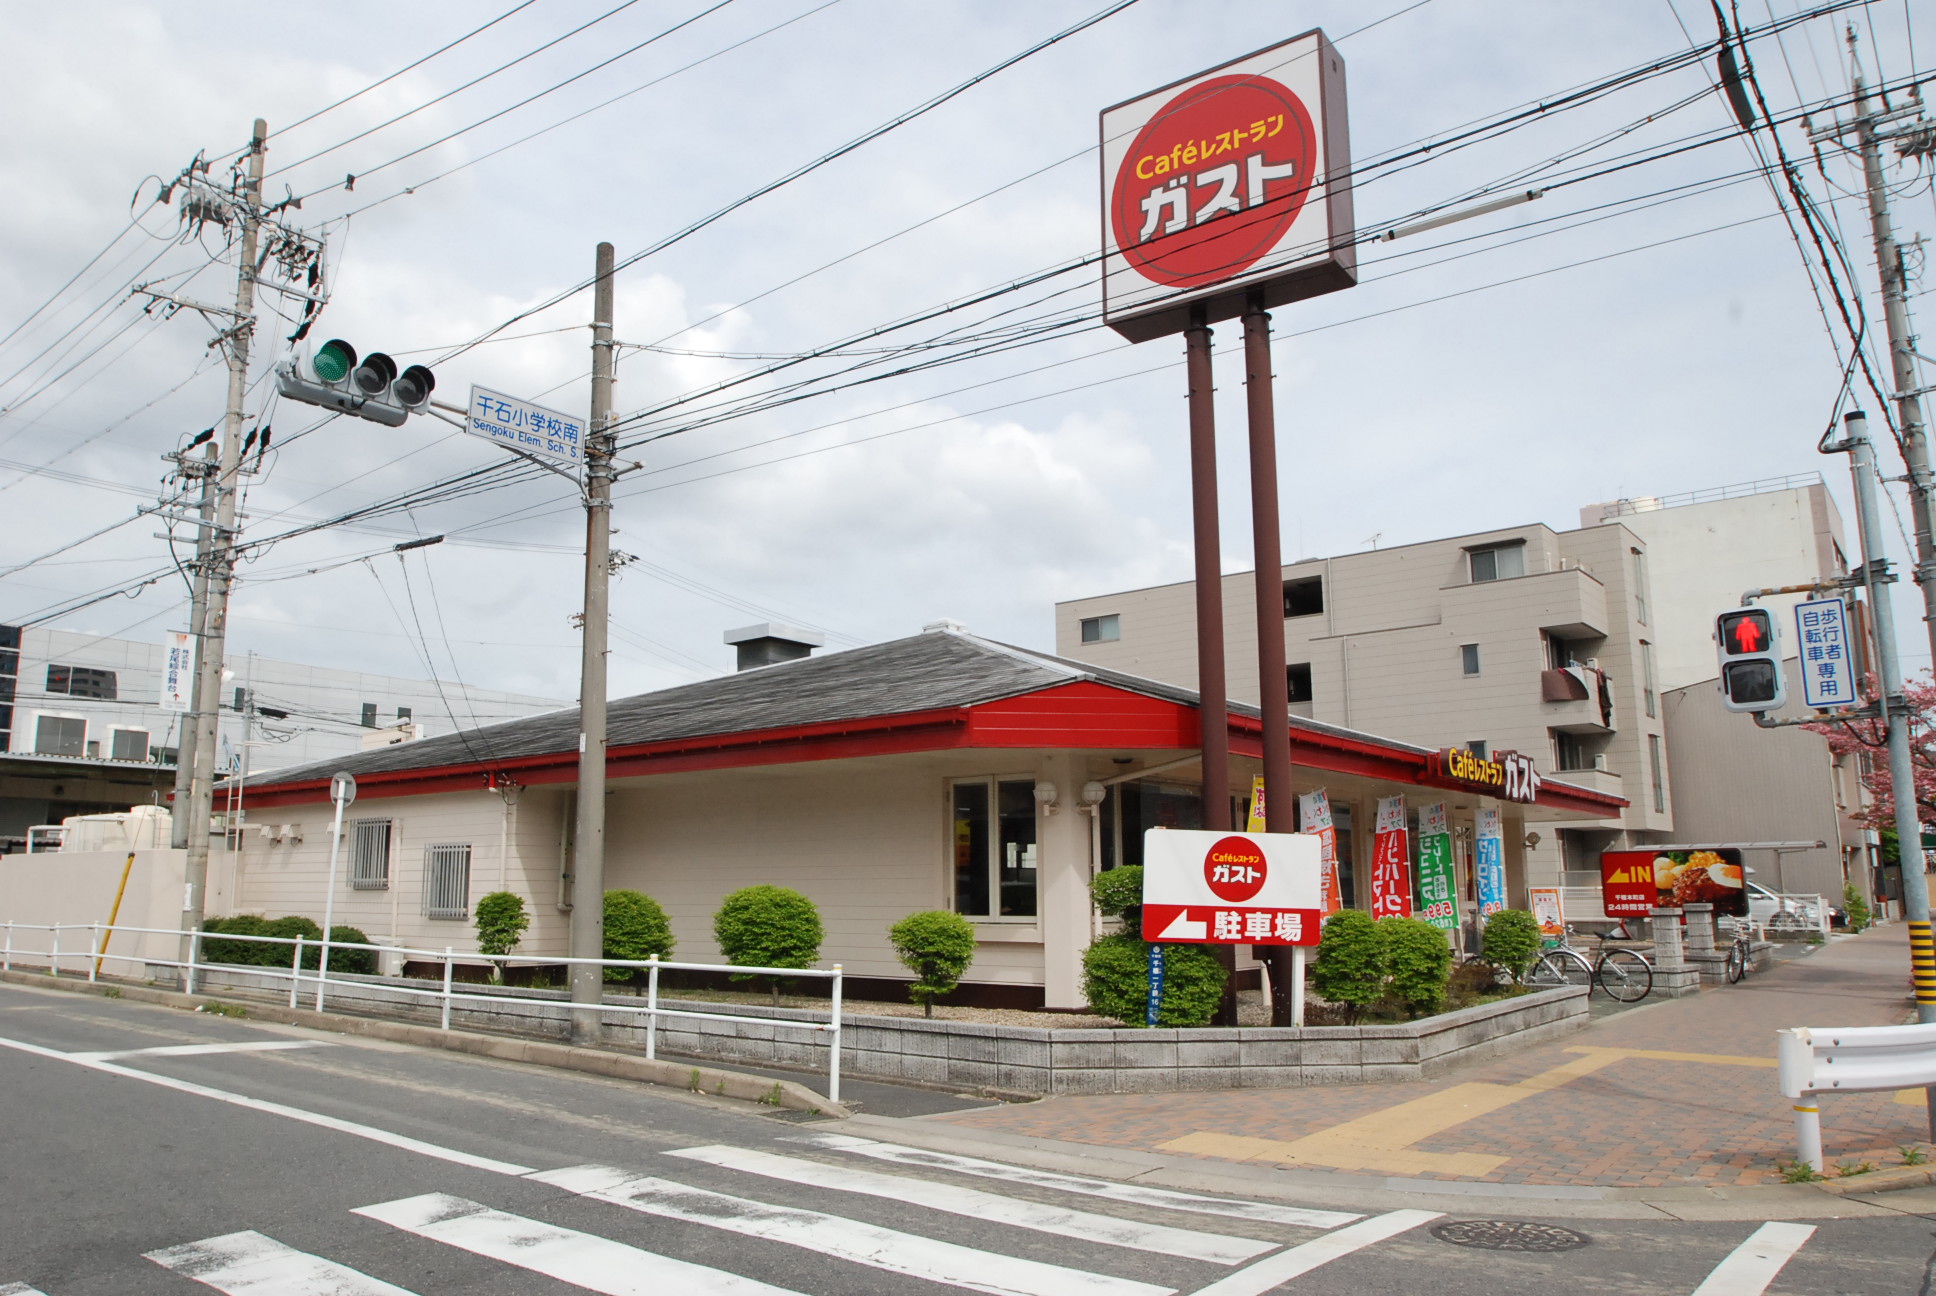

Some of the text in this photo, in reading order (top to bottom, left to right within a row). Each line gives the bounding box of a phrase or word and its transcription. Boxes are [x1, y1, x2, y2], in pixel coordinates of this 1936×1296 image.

[1139, 153, 1294, 243] ガスト
[473, 418, 579, 459] Sengoku Elem. Sch. S.
[476, 395, 579, 444] 千石小学校南
[1803, 611, 1824, 661] 自転車
[1820, 609, 1842, 660] 歩行者
[1817, 662, 1839, 697] 専用
[1505, 753, 1541, 801] ガスト
[1212, 864, 1262, 884] ガスト
[1631, 866, 1652, 883] IN
[1213, 911, 1303, 942] 駐車場
